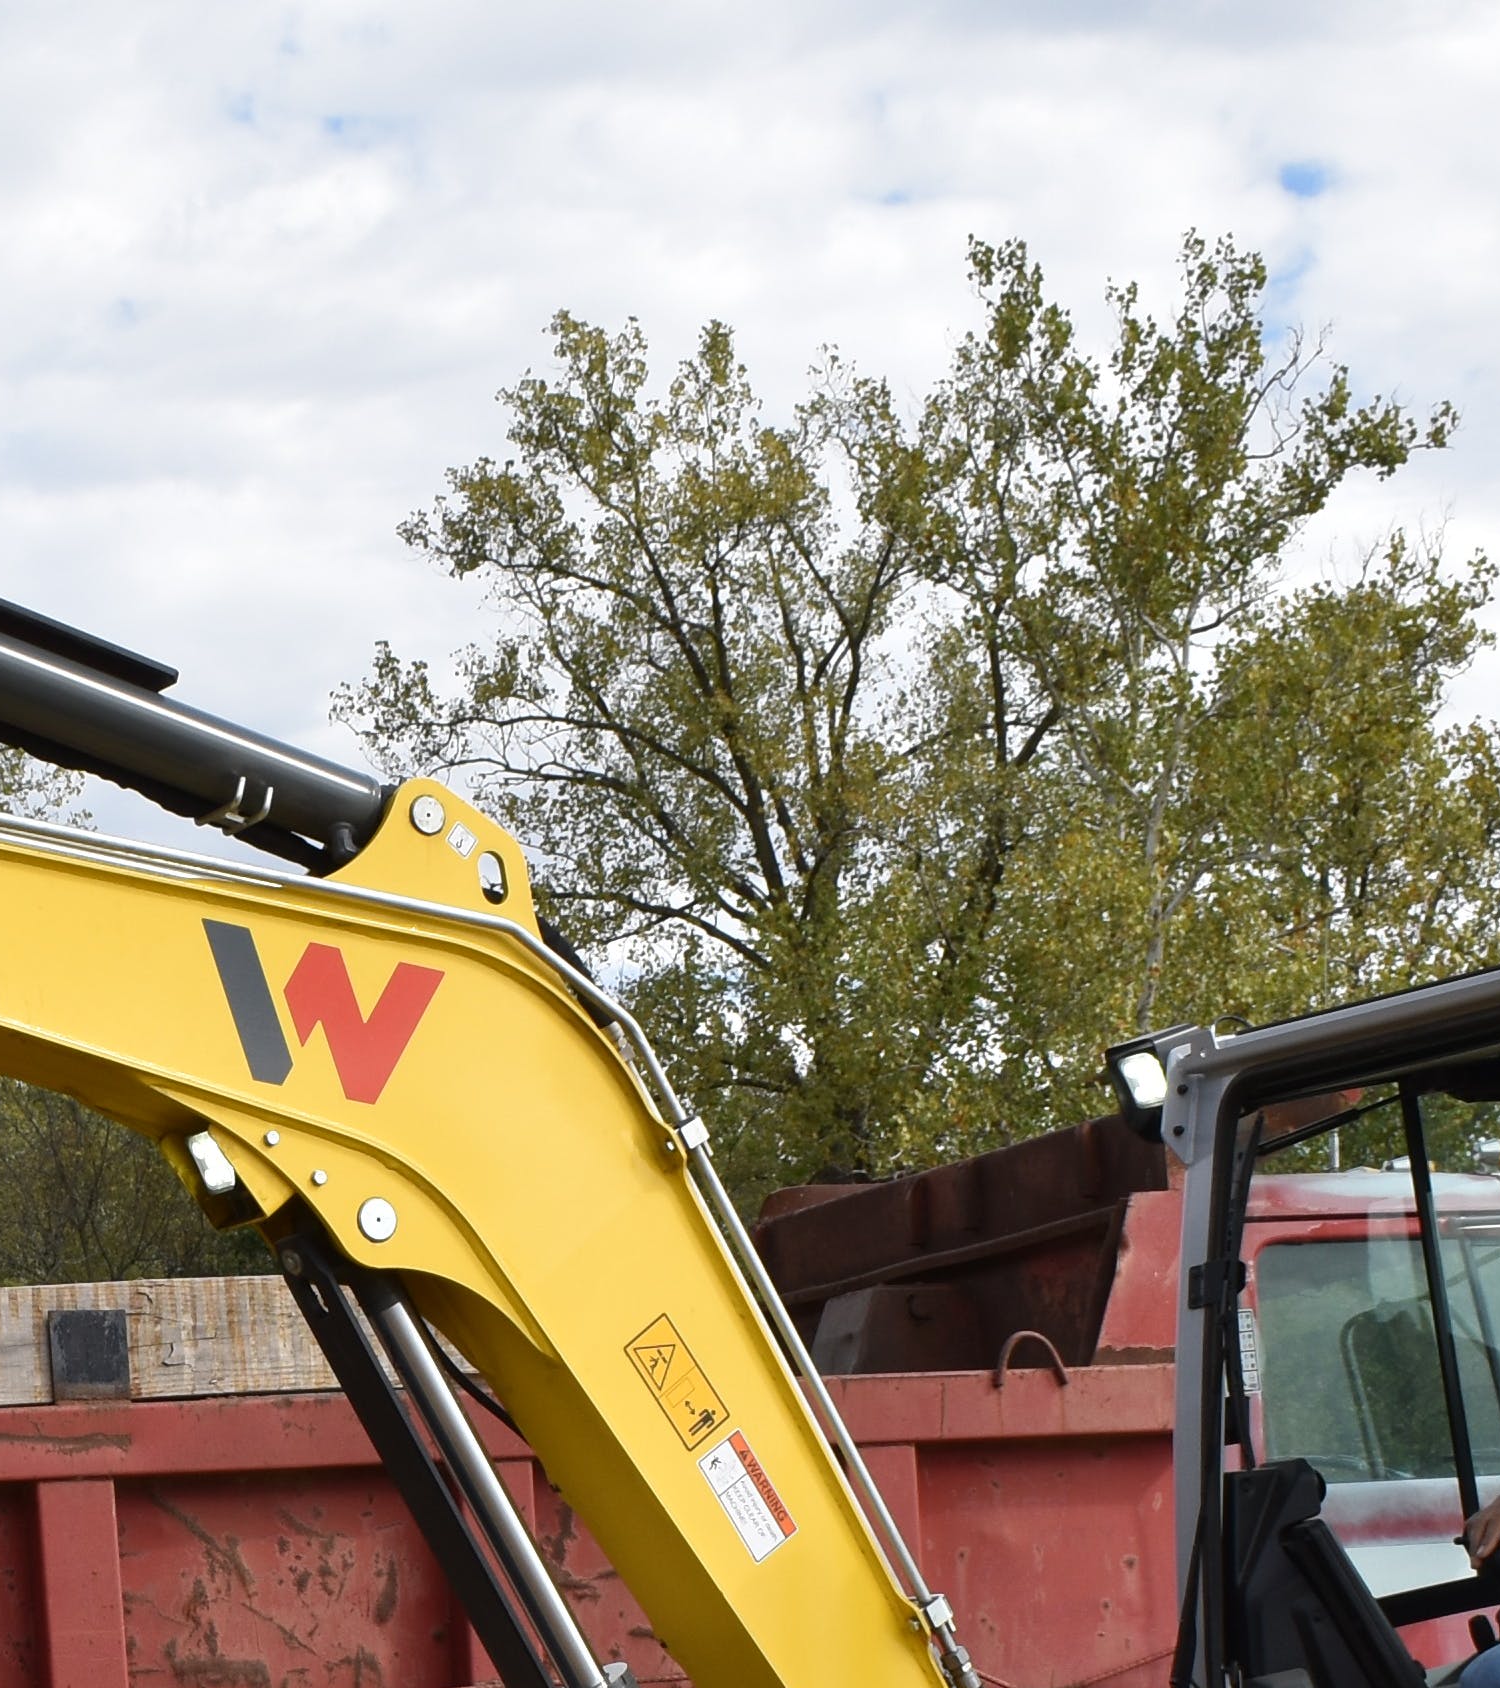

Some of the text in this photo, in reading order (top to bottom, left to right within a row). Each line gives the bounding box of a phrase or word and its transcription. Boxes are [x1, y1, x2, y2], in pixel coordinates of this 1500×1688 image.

[733, 1485, 746, 1503] KEEP
[743, 1504, 761, 1528] CLEAR
[747, 1459, 785, 1522] WARNING
